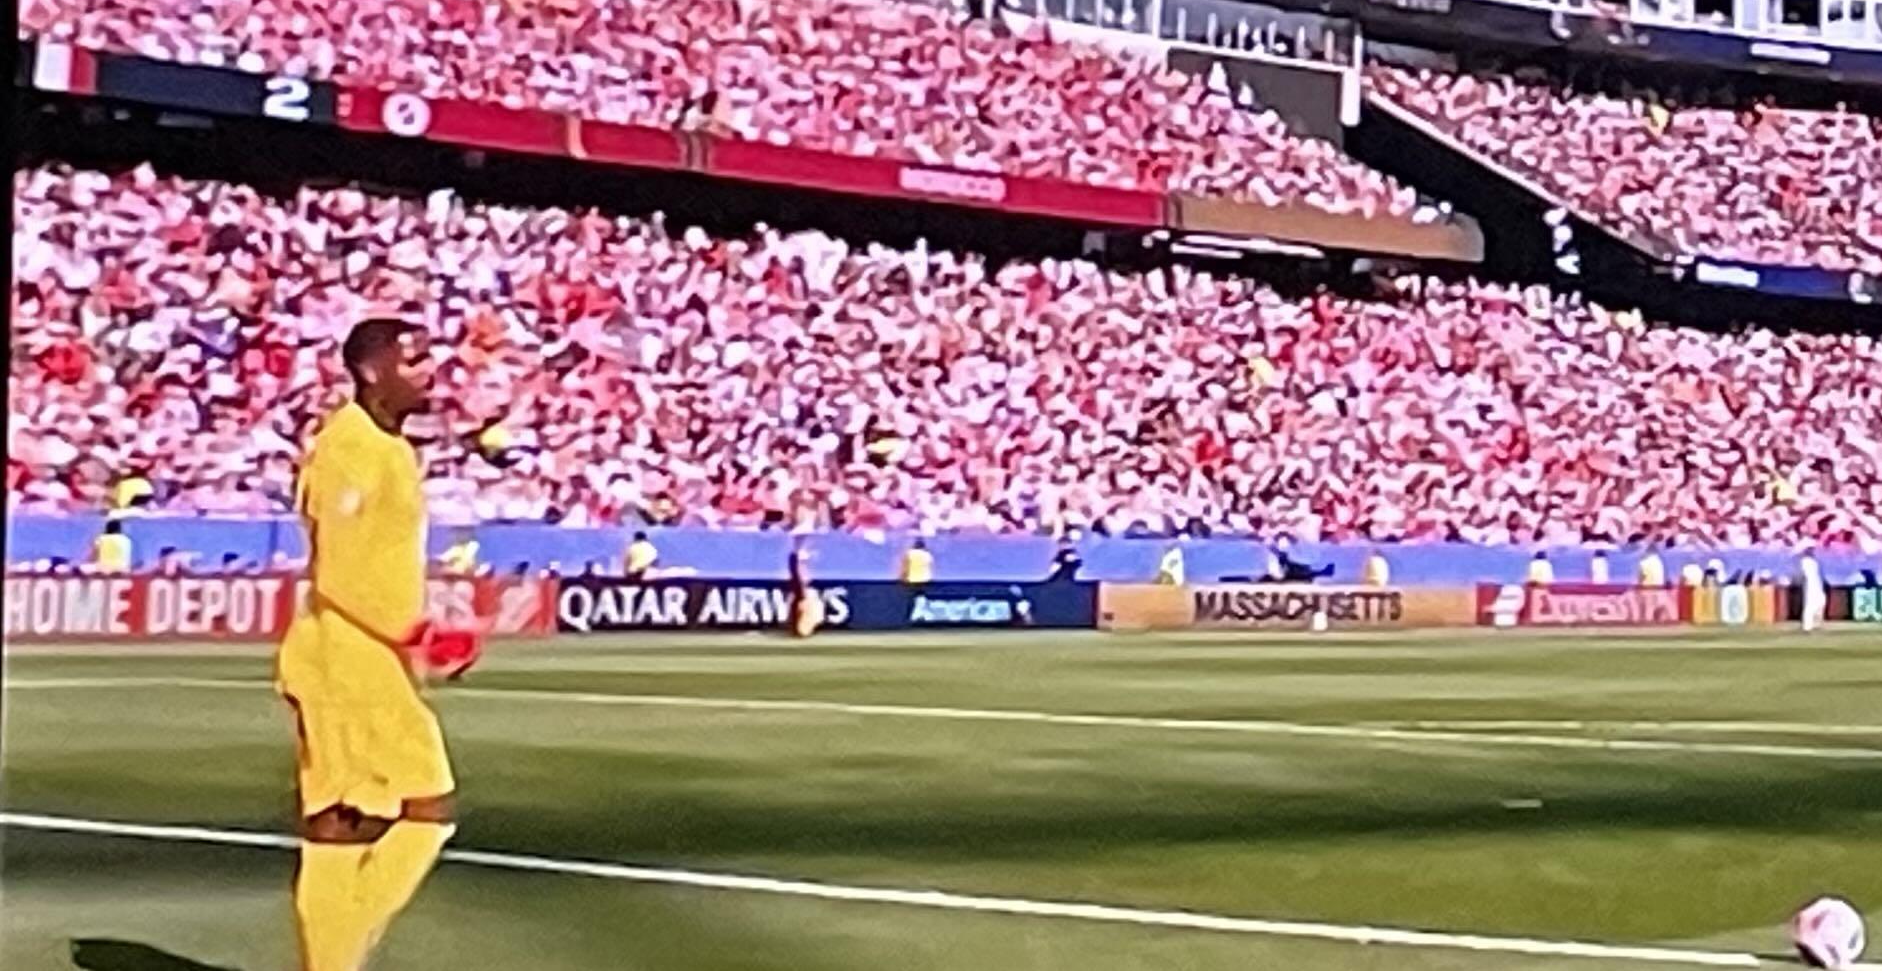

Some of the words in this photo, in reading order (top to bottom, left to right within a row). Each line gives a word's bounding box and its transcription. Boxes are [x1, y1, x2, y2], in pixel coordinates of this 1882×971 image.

[263, 77, 310, 122] 2
[383, 93, 432, 137] 0
[4, 578, 133, 634] HOME
[148, 578, 282, 634] DEPOT
[559, 585, 688, 632] QATAR
[700, 586, 850, 625] AIRWS
